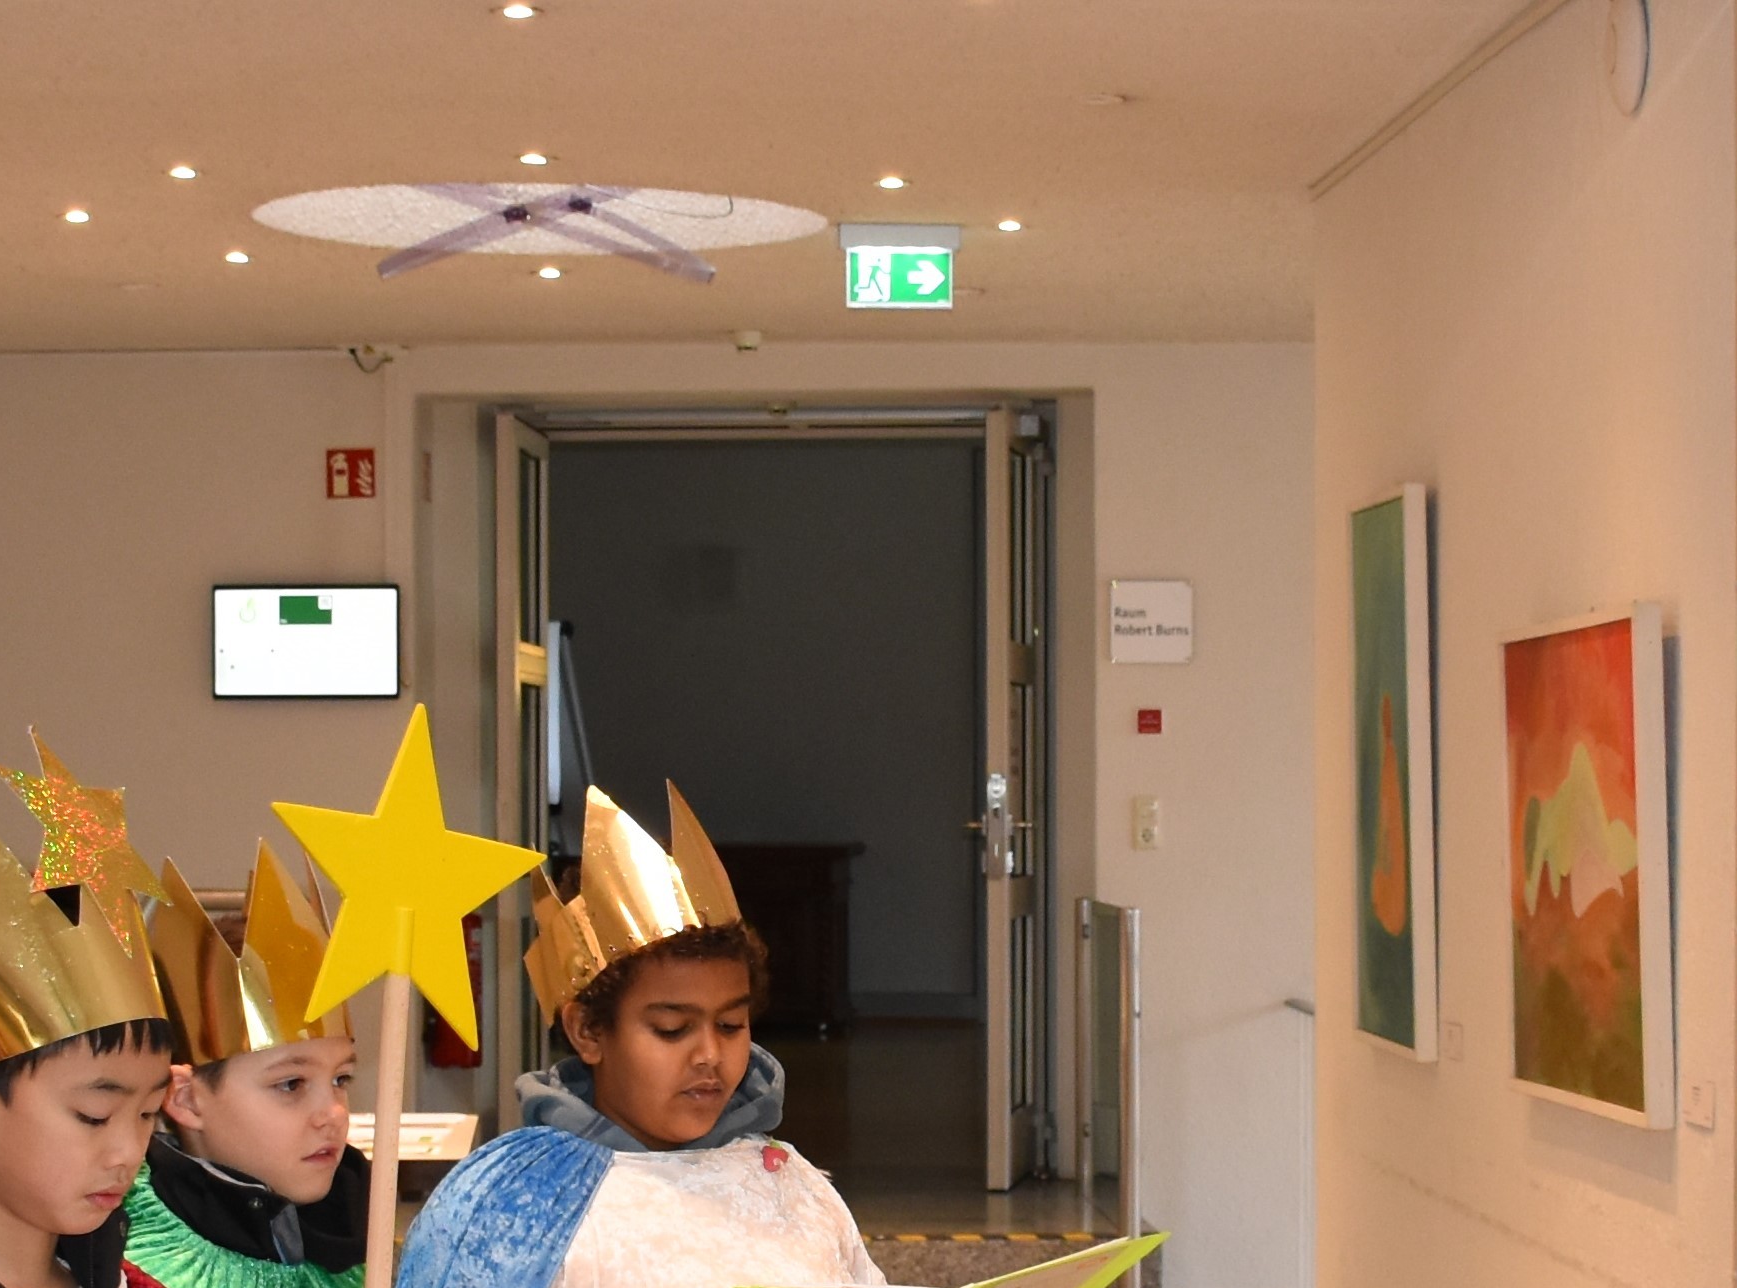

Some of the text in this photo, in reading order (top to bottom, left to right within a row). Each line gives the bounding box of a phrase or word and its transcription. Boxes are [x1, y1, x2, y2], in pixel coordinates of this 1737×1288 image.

[1114, 606, 1146, 618] Raum
[1114, 624, 1189, 636] Robert Burns
